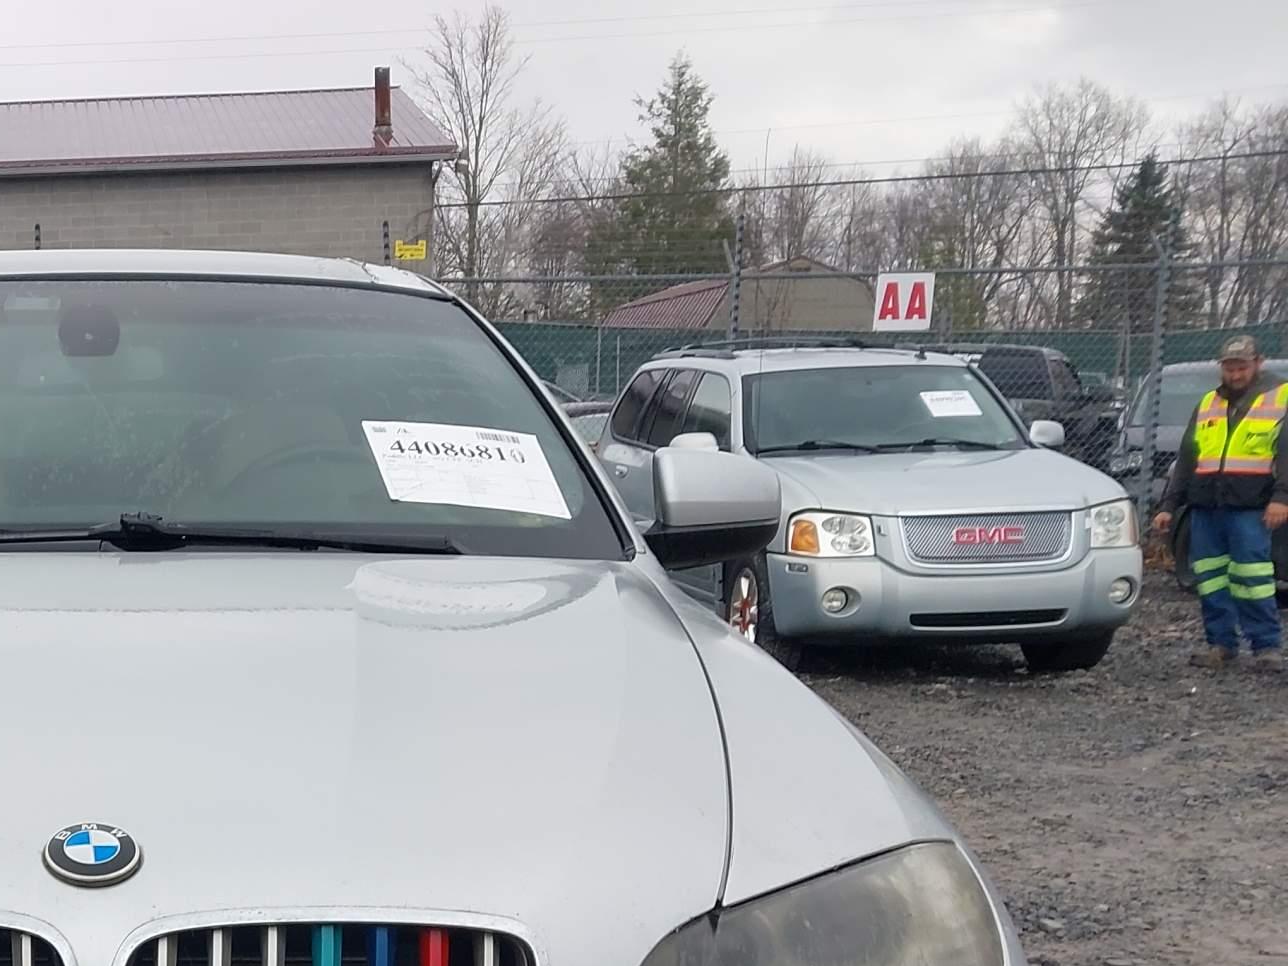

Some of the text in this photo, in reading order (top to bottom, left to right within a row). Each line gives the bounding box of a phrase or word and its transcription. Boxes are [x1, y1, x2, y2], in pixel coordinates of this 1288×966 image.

[878, 281, 927, 320] AA
[389, 438, 526, 464] 44086810
[952, 526, 1025, 545] GMC
[54, 823, 128, 841] BMW
